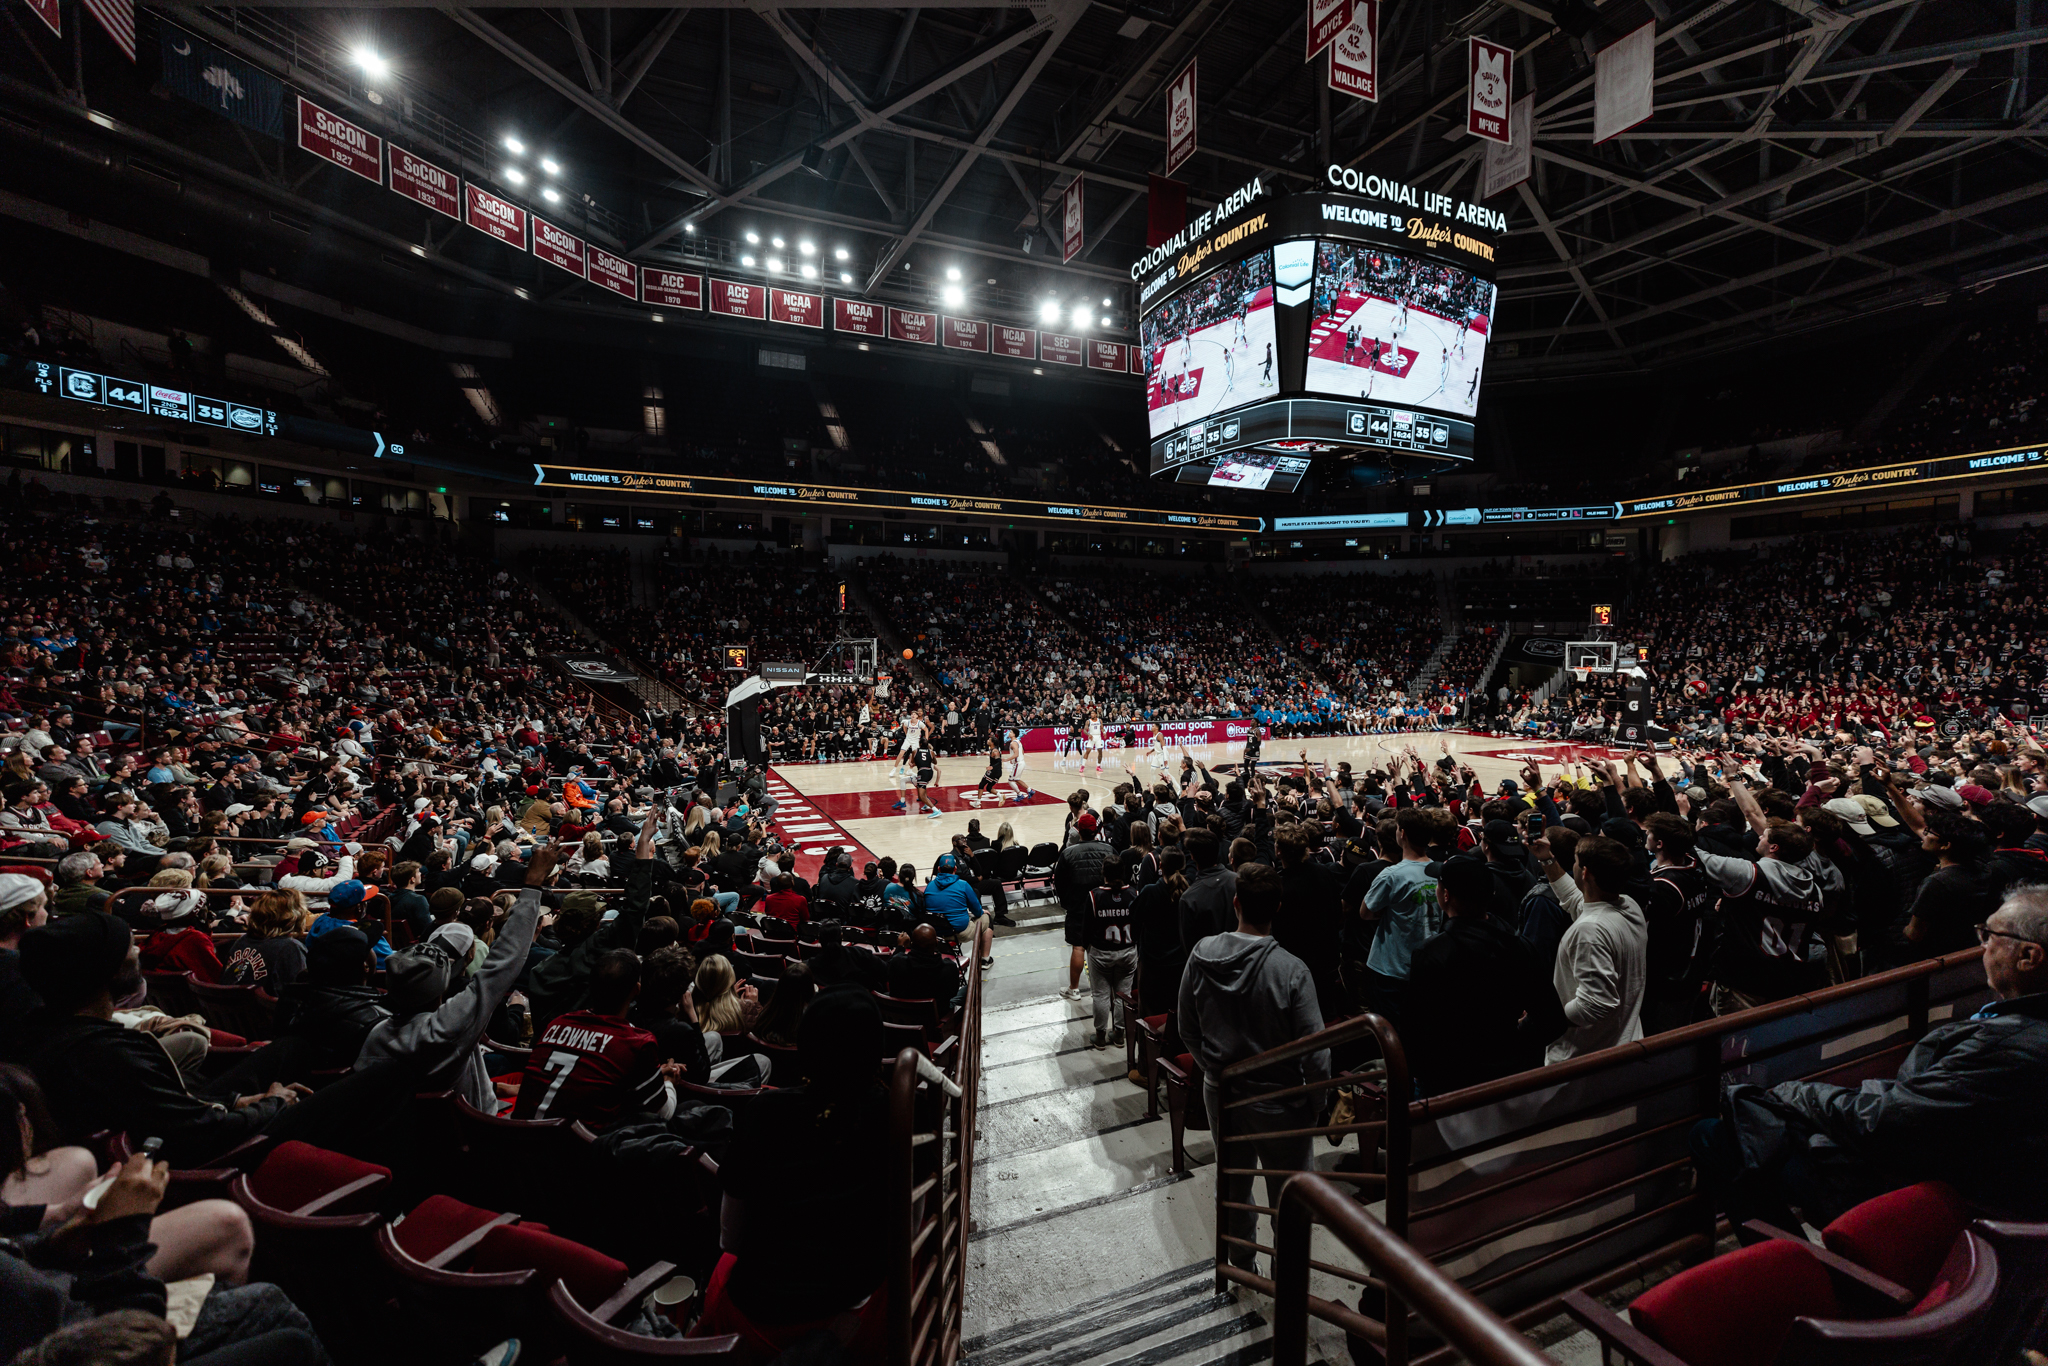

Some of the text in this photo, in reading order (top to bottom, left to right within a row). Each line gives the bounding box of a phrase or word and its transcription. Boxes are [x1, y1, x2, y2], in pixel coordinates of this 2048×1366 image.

[1316, 9, 1344, 44] JOYCE
[1347, 34, 1360, 49] 42
[1338, 43, 1368, 62] CAROLINA
[1334, 69, 1373, 94] WALLACE
[1481, 71, 1501, 85] SOUTH
[1487, 83, 1493, 95] 3
[1476, 91, 1503, 109] CAROLINA
[331, 148, 353, 166] 1927
[351, 146, 378, 164] CHAMPION
[417, 189, 436, 205] 1933
[434, 188, 457, 203] CHAMPION
[1328, 164, 1508, 233] COLONIAL LIFE ARENA
[489, 223, 506, 238] 1933
[1131, 176, 1263, 281] COLONIAL LIFE ARENA
[1321, 203, 1495, 262] WELCOME TO Duke's COUNTRY.
[552, 253, 568, 267] 1934
[1141, 213, 1268, 305] WELCOME TO Duke's COUNTRY.
[1279, 258, 1300, 271] Colonial
[606, 278, 621, 290] 1945
[661, 273, 685, 289] ACC
[679, 289, 699, 297] CHAMPION
[727, 285, 749, 299] ACC
[664, 295, 681, 305] 1970
[783, 293, 811, 309] NCAA
[730, 305, 746, 315] 1971
[846, 303, 873, 318] NCAA
[790, 314, 804, 324] 1971
[900, 312, 926, 328] NCAA
[852, 323, 867, 332] 1972
[953, 320, 978, 335] NCAA
[906, 332, 920, 341] 1973
[1002, 328, 1026, 343] NCAA
[1054, 336, 1070, 349] SEC
[959, 340, 973, 348] 1974
[1097, 343, 1118, 356] NCAA
[36, 361, 50, 371] TO
[38, 369, 49, 378] 3
[35, 377, 52, 386] FLS
[40, 384, 48, 393] 1
[109, 387, 143, 404] 44
[161, 401, 178, 409] 2ND
[152, 406, 189, 420] 16:24
[198, 405, 225, 420] 35
[265, 422, 279, 430] FLS
[269, 428, 275, 436] 1
[1370, 420, 1388, 433] 44
[1395, 422, 1409, 430] 2ND
[1415, 426, 1430, 439] 35
[1207, 430, 1219, 443] 35
[1392, 430, 1412, 440] 16:24
[392, 445, 403, 453] CC
[1176, 441, 1187, 453] 44
[1969, 451, 2041, 469] WELCOME TO
[570, 473, 610, 483] WELCOME
[622, 475, 654, 486] Duke's
[655, 479, 693, 489] COUNTRY.
[1777, 480, 1819, 493] WELCOME
[1832, 472, 1869, 488] Duke's
[1871, 467, 1919, 481] COUNTRY.
[753, 486, 788, 495] WELCOME
[797, 487, 825, 498] Duke's
[826, 491, 859, 500] COUNTRY.
[911, 497, 940, 505] WELCOME
[974, 502, 1002, 510] COUNTRY.
[1633, 501, 1665, 512] WELCOME
[1705, 491, 1741, 502] COUNTRY.
[1047, 507, 1074, 515] WELCOME
[1167, 515, 1191, 523] WELCOME
[1601, 613, 1609, 624] 5
[735, 657, 744, 667] 5
[1628, 700, 1639, 712] G
[1174, 732, 1208, 746] today!
[921, 752, 927, 761] 5
[1097, 908, 1130, 918] GAMECOC
[1760, 916, 1807, 962] 01
[542, 1025, 614, 1053] CLOWNEY
[534, 1050, 580, 1120] 7
